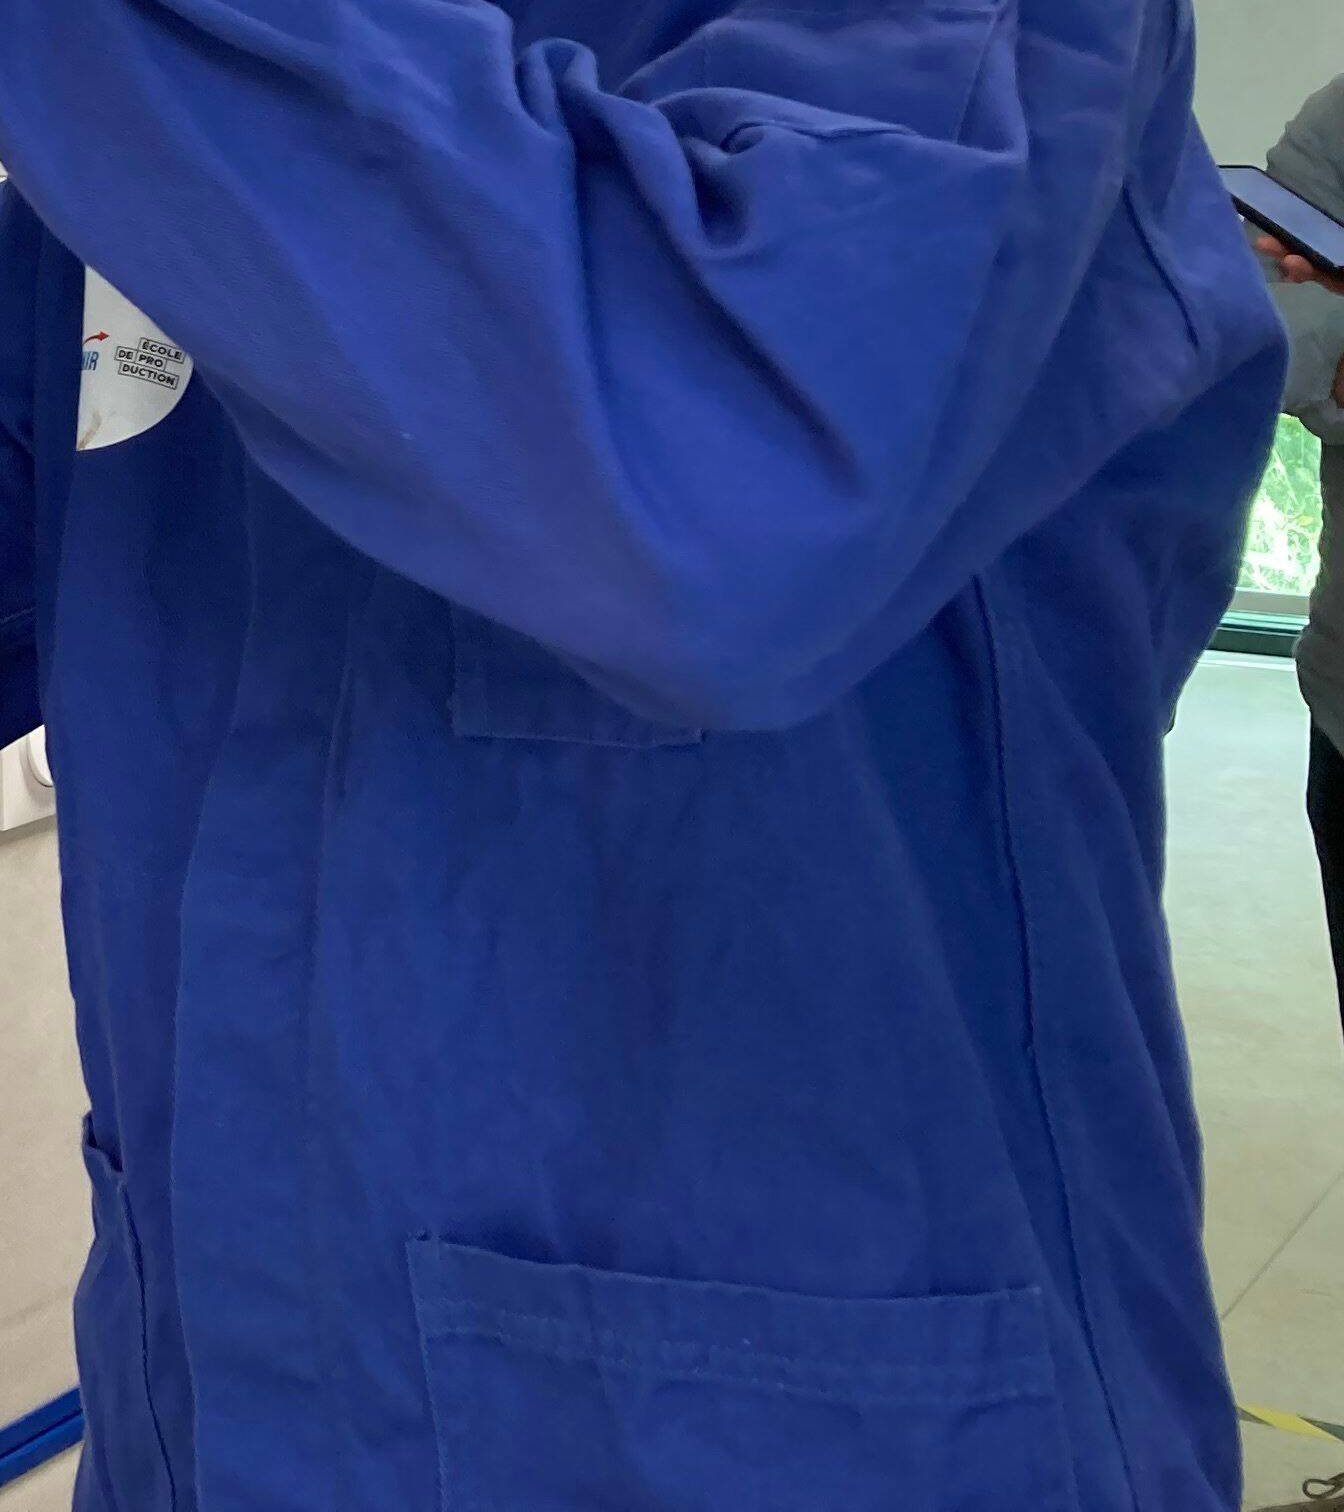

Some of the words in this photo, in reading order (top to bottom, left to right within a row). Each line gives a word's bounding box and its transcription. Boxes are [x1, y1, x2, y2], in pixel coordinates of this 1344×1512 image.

[118, 349, 133, 360] DE
[139, 354, 164, 368] PRO
[141, 339, 182, 360] ÉCOLE
[122, 363, 177, 386] DUCTION
